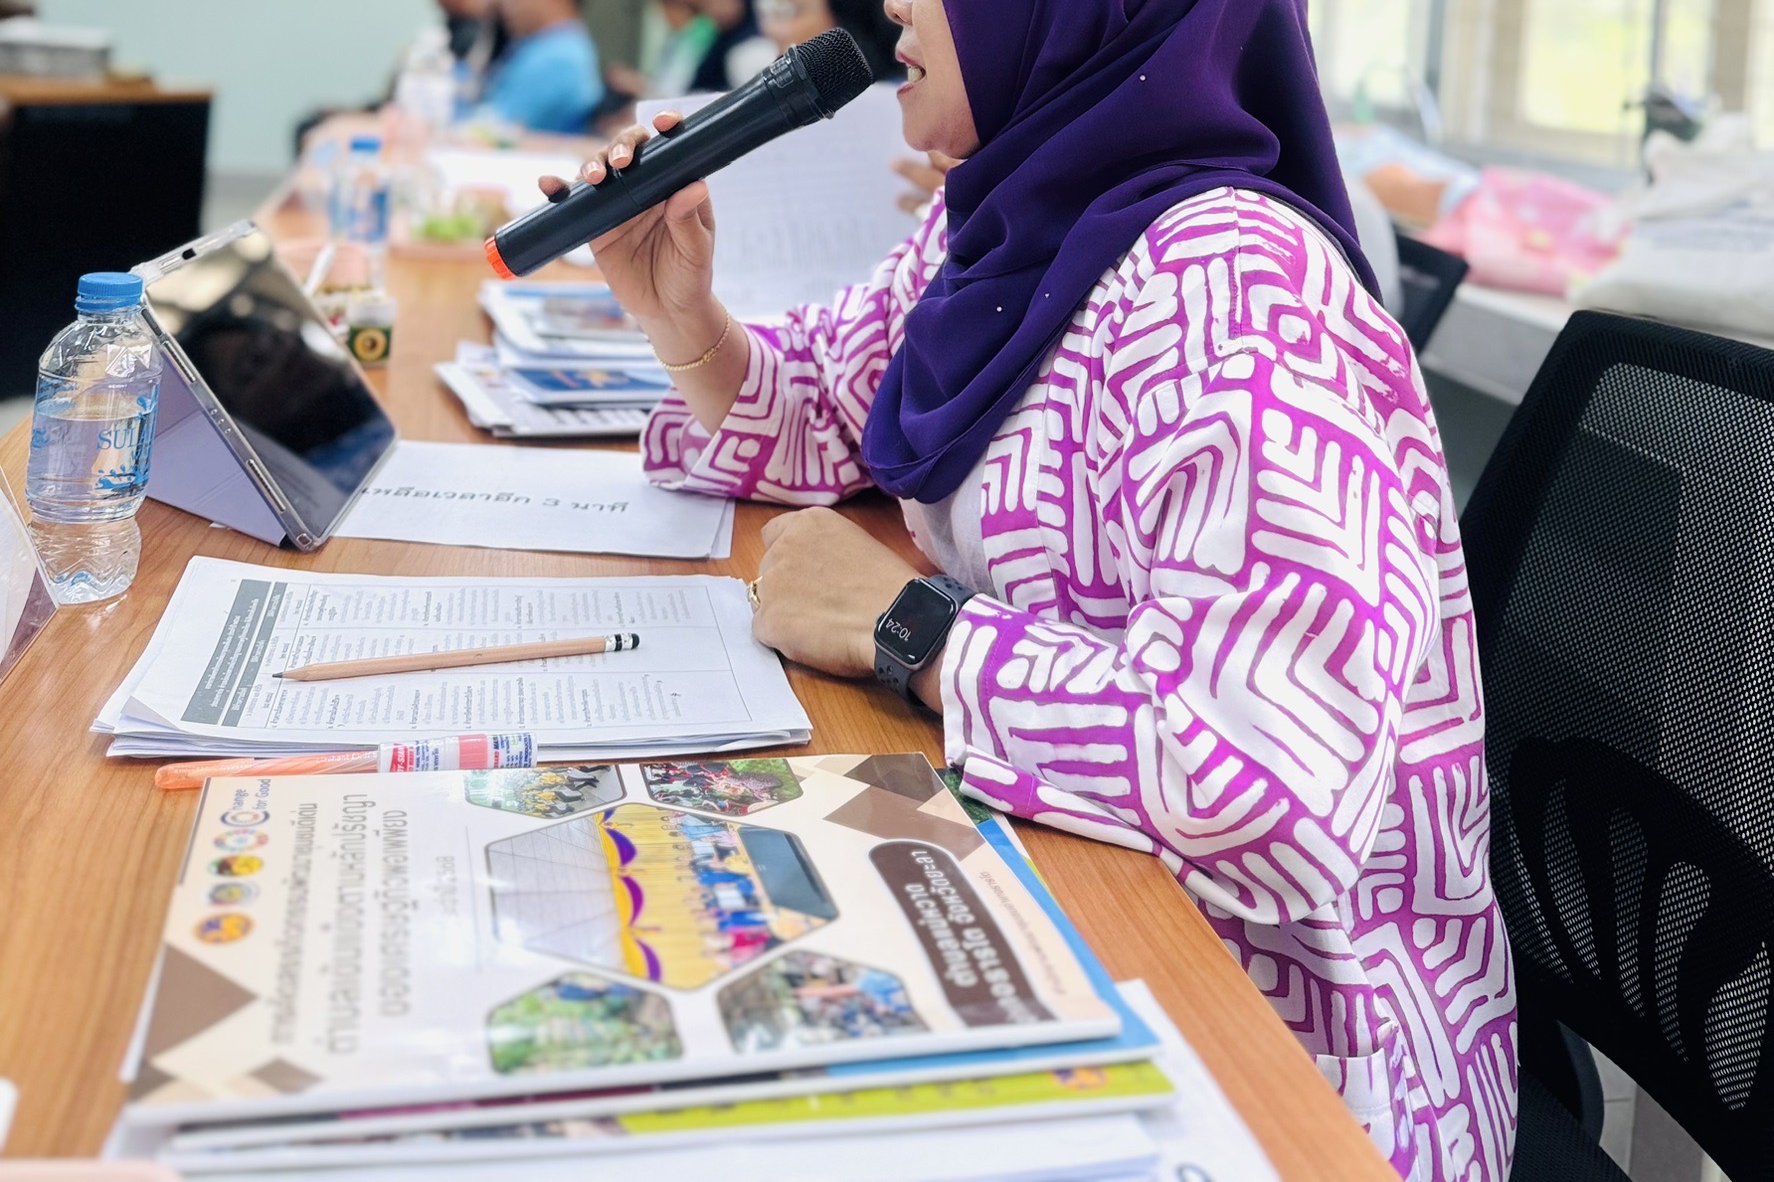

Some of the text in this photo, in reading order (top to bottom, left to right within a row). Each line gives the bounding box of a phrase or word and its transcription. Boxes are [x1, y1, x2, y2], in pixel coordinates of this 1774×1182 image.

[362, 486, 630, 513] เหลือเวลาอีก 3 นาที
[885, 618, 912, 643] 10:24
[252, 778, 271, 811] for Good
[910, 848, 977, 927] จังหวัดยะลา
